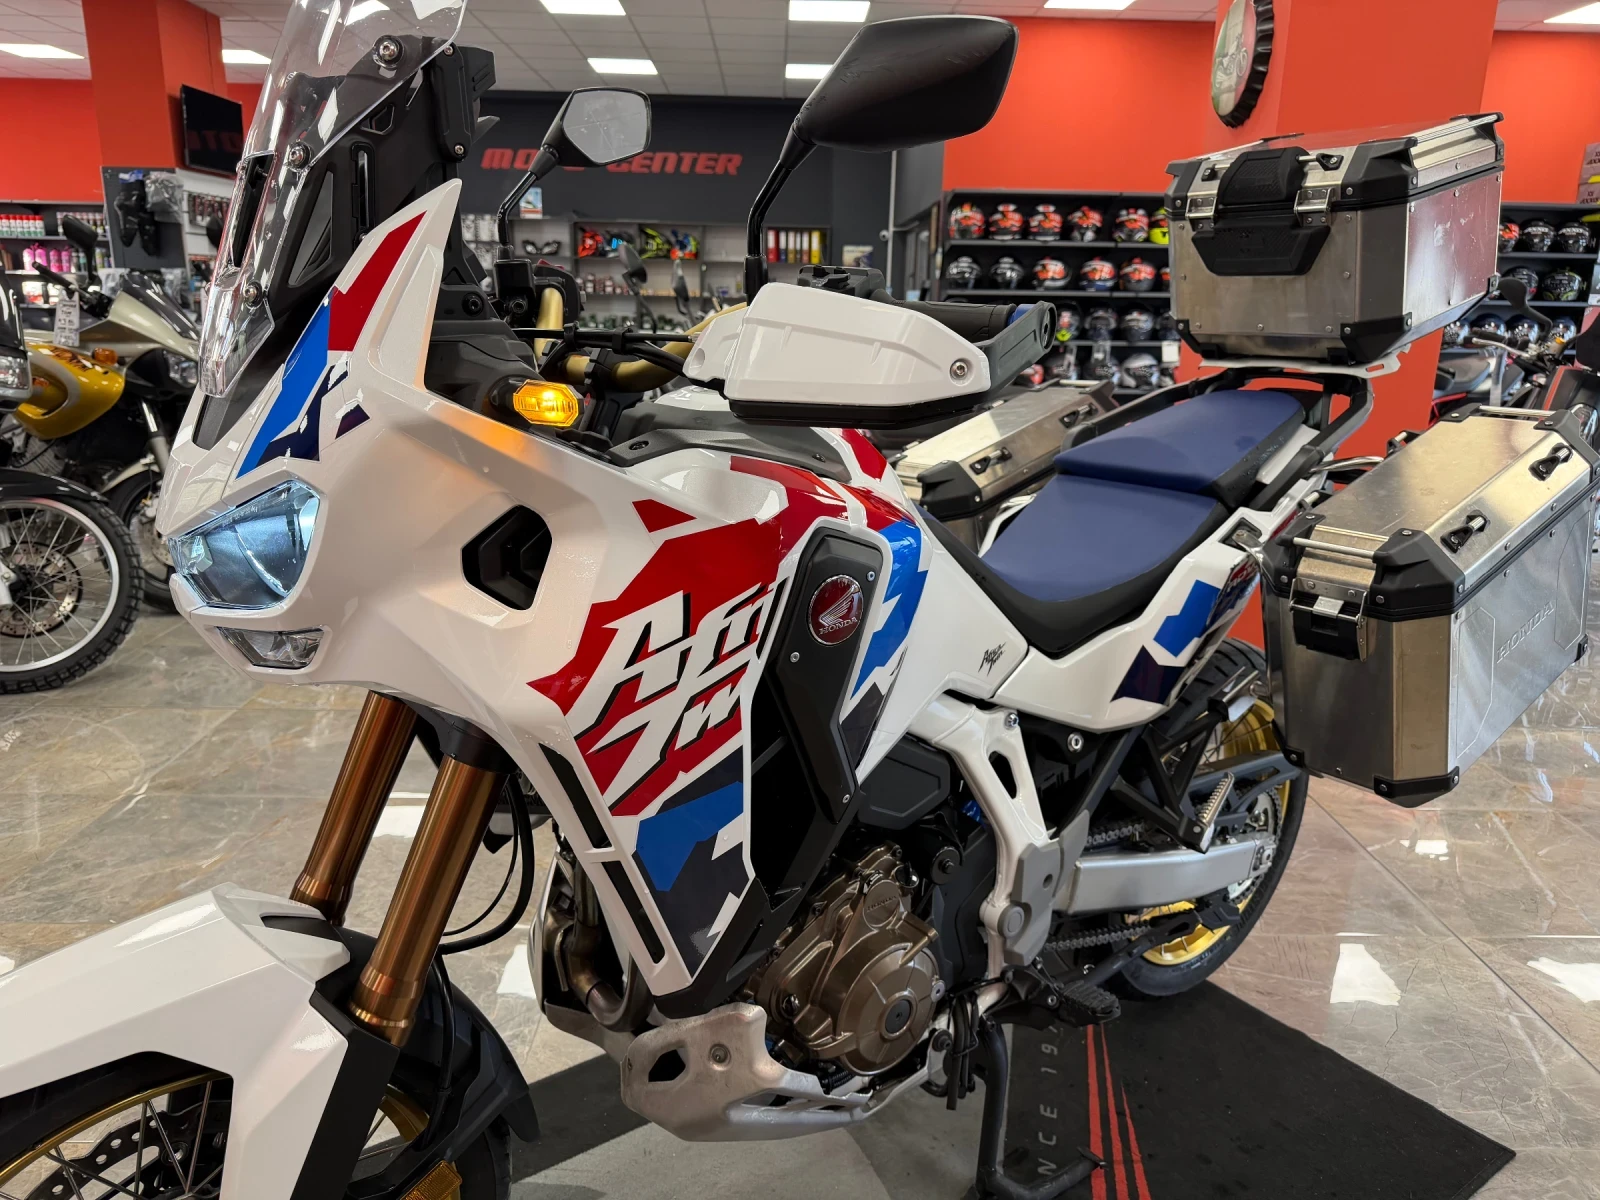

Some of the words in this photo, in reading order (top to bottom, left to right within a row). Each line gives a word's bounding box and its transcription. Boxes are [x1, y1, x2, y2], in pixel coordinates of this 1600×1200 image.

[480, 147, 576, 172] MO
[819, 616, 858, 635] HONDA
[1497, 601, 1555, 664] HONDA
[867, 896, 897, 912] HONDA
[1040, 1026, 1058, 1074] 19
[1038, 1103, 1058, 1176] NCE
